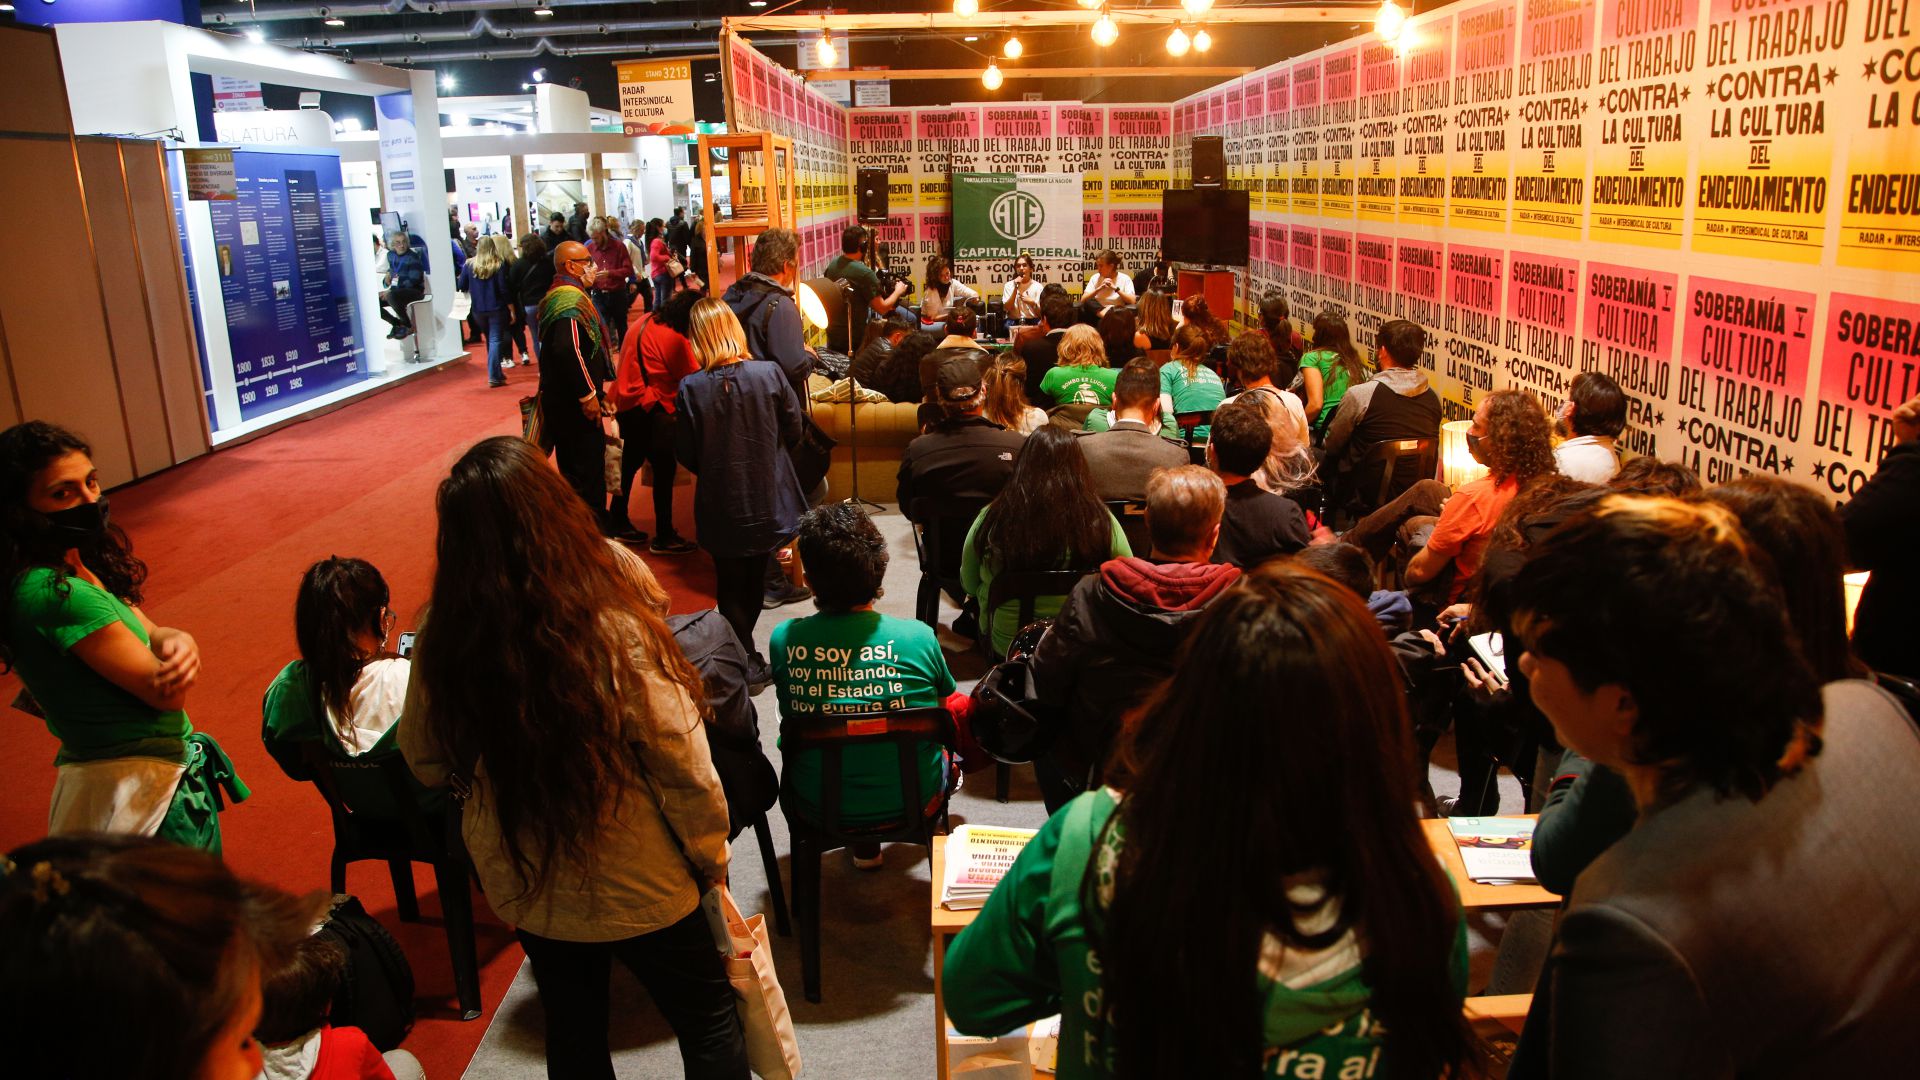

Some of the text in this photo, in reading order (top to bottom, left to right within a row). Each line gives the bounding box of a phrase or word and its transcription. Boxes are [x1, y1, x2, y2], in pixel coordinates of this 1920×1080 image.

[1616, 0, 1682, 38] CULTURA
[1533, 15, 1583, 57] CULTURA
[1707, 0, 1848, 67] DEL TRABAJO
[1465, 34, 1505, 71] CULTURA
[1599, 30, 1696, 84] DEL TRABAJO
[664, 67, 688, 78] 3213
[1411, 50, 1444, 83] CULTURA
[1519, 53, 1592, 96] DEL TRABAJO
[1366, 63, 1395, 92] CULTURA
[1472, 68, 1512, 103] TRABAJO
[1718, 63, 1820, 102] CONTRA
[622, 86, 645, 95] RADAR
[1417, 81, 1450, 111] TRABAJO
[1607, 82, 1679, 114] CONTRA
[624, 96, 673, 106] INTERSINDICAL
[1525, 97, 1580, 122] CONTRA
[1868, 91, 1899, 128] LA
[635, 108, 664, 117] CULTURA
[854, 113, 899, 125] SOBERANÍA
[988, 109, 1038, 121] SOBERANÍA
[1114, 111, 1159, 120] SOBERANÍA
[1459, 106, 1503, 128] CONTRA
[1711, 101, 1824, 138] LA CULTURA
[860, 126, 902, 139] CULTURA
[995, 122, 1041, 136] CULTURA
[1120, 121, 1161, 135] CULTURA
[1363, 122, 1393, 139] CONTRA
[1407, 115, 1442, 134] CONTRA
[1602, 114, 1681, 144] LA CULTURA
[918, 139, 933, 152] DEL
[984, 138, 1050, 152] DEL TRABAJO
[1057, 137, 1074, 150] DEL
[1109, 136, 1170, 149] DEL TRABAJO
[1414, 136, 1444, 154] CULTURA
[1457, 130, 1505, 152] LA CULTURA
[1522, 124, 1582, 149] LA CULTURA
[851, 140, 912, 153] DEL TRABAJO
[1117, 151, 1163, 159] CONTRA
[1370, 141, 1395, 158] CULTURA
[1750, 145, 1770, 164] DEL
[858, 155, 906, 164] CONTRA
[992, 154, 1043, 164] CONTRA
[1129, 161, 1165, 169] CULTURA
[1631, 151, 1644, 166] DEL
[924, 164, 934, 173] LA
[1111, 180, 1168, 190] ENDEUDAMIENTO
[1452, 177, 1506, 200] ENDEUDAMIENTO
[1515, 176, 1583, 205] ENDEUDAMIENTO
[1594, 176, 1683, 208] ENDEUDAMIENTO
[1699, 175, 1826, 214] ENDEUDAMIENTO
[1113, 213, 1158, 222] SOBERANÍA
[1652, 221, 1672, 230] CULTURA
[1119, 223, 1161, 236] CULTURA
[1706, 223, 1724, 233] RADAR
[1731, 225, 1769, 237] INTERSINDICAL
[1781, 230, 1808, 241] CULTURA
[1859, 233, 1884, 244] RADAR
[959, 248, 1080, 257] CAPITAL FEDERAL
[1109, 238, 1125, 250] DEL
[1403, 267, 1435, 298] CULTURA
[1513, 262, 1563, 291] SOBERANÍA
[1455, 276, 1493, 311] CULTURA
[1591, 273, 1656, 309] SOBERANÍA
[1395, 293, 1441, 330] DEL TRABAJO
[1518, 287, 1565, 329] CULTURA
[1694, 290, 1785, 335] SOBERANÍA
[1445, 304, 1500, 346] DEL TRABAJO
[1597, 303, 1658, 353] CULTURA
[318, 342, 330, 352] 1982
[1450, 338, 1491, 369] CONTRA
[1506, 320, 1573, 369] DEL TRABAJO
[261, 355, 275, 367] 1833
[286, 350, 298, 361] 1910
[1701, 325, 1788, 386] CULTURA
[237, 361, 251, 374] 1800
[346, 362, 357, 372] 2021
[1447, 359, 1493, 392] LA CULTURA
[1512, 358, 1562, 394] CONTRA
[1608, 346, 1669, 400] TRABAJO
[265, 384, 278, 397] 1910
[290, 378, 303, 390] 1982
[1061, 378, 1080, 390] BOMBO
[1090, 378, 1107, 391] LUCHA
[242, 391, 256, 404] 1900
[1679, 366, 1706, 412] DEL
[1715, 375, 1802, 442] TRABAJO
[1814, 400, 1853, 457] DEL
[1688, 417, 1779, 475] CONTRA
[787, 640, 898, 667] yo soy así,
[788, 664, 901, 682] voy militando,
[790, 681, 903, 698] en el Estado le
[890, 696, 906, 709] al
[1339, 1046, 1381, 1079] al
